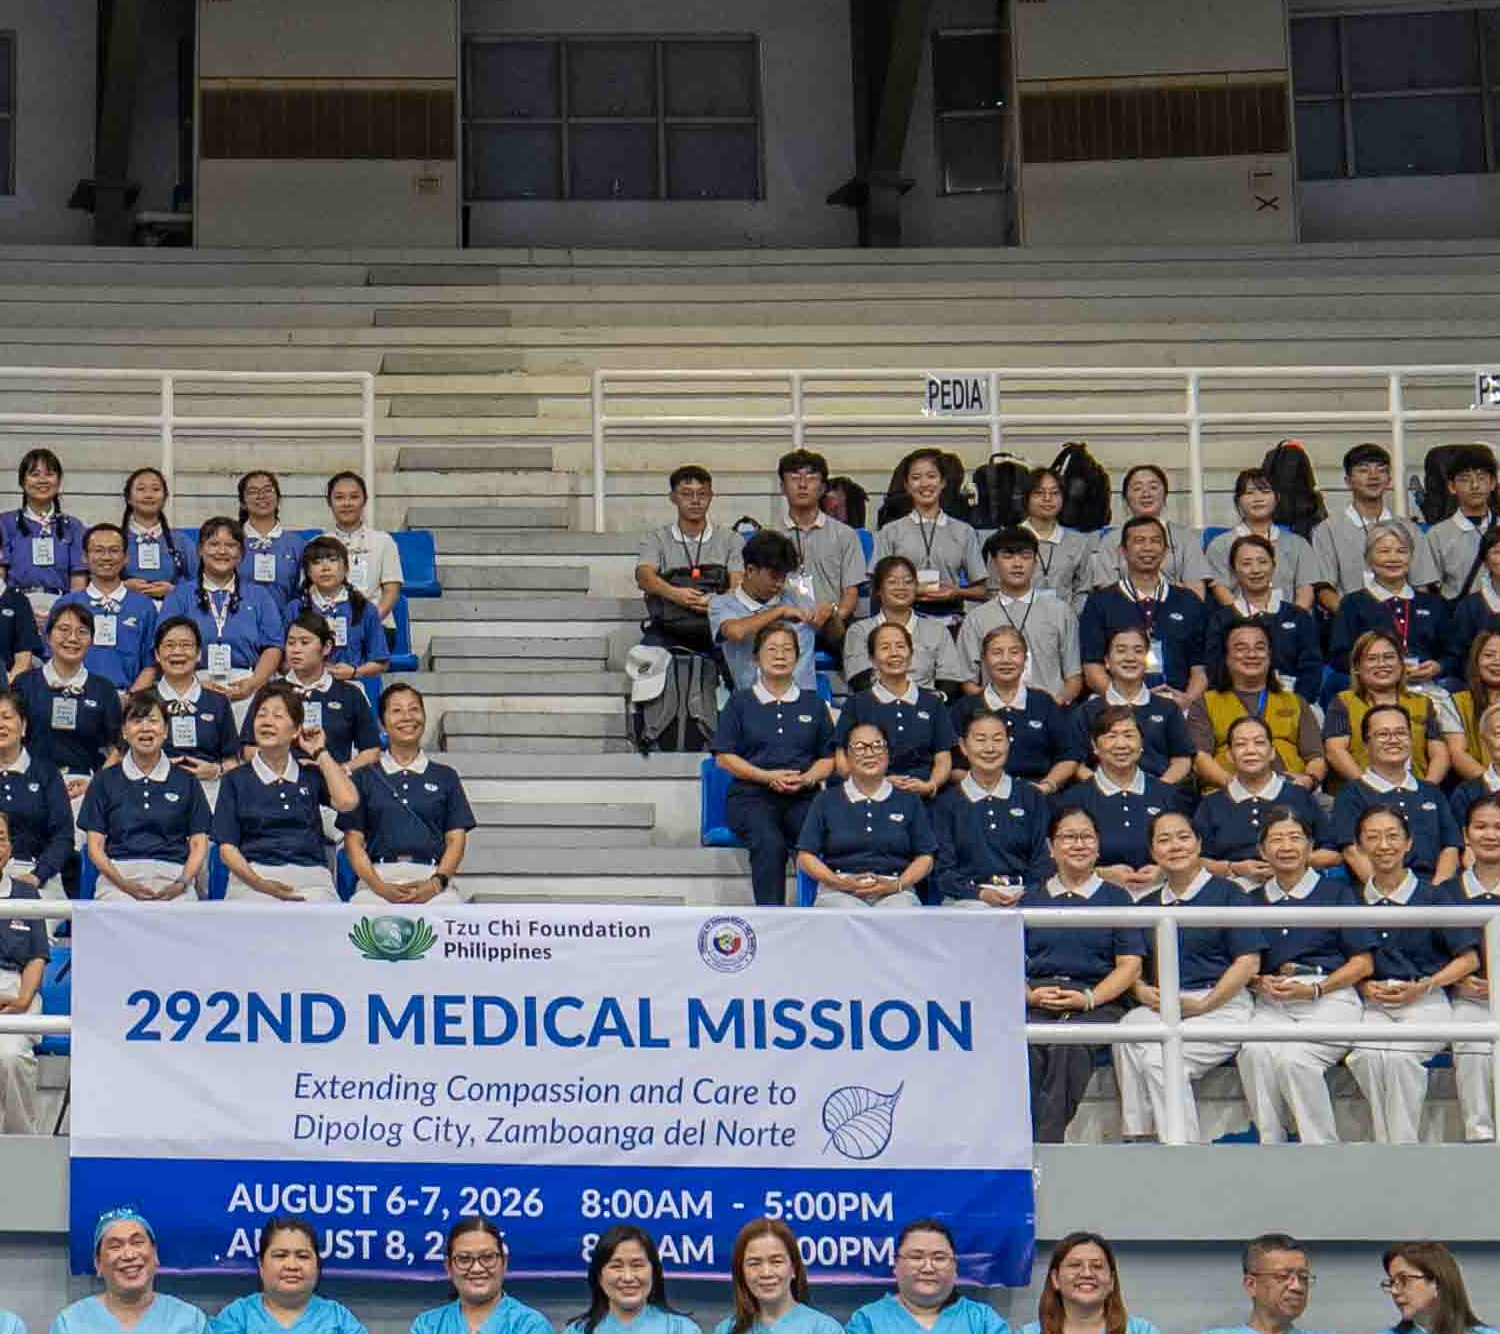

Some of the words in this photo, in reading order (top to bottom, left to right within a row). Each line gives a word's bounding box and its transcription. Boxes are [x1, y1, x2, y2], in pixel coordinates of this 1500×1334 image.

[928, 378, 984, 410] PEDIA
[444, 919, 480, 937] Tzu
[487, 919, 521, 937] Chi
[528, 919, 651, 939] Foundation
[444, 941, 552, 963] Philippines
[125, 989, 347, 1044] 292ND
[367, 994, 670, 1049] MEDICAL
[687, 997, 974, 1052] MISSION
[294, 1072, 439, 1107] Extending
[447, 1074, 620, 1107] Compassion
[629, 1077, 684, 1104] and
[693, 1077, 759, 1105] Care
[767, 1080, 797, 1105] to
[293, 1113, 403, 1148] Dipolog
[412, 1115, 476, 1148] City,
[485, 1117, 654, 1151] Zamboanga
[664, 1118, 706, 1146] del
[715, 1120, 796, 1147] Norte
[227, 1182, 377, 1214] AUGUST
[385, 1185, 450, 1220] 6-7,
[458, 1186, 545, 1217] 2026
[580, 1188, 713, 1220] 8:00AM
[764, 1191, 894, 1222] 5:00PM
[385, 1229, 415, 1266] 8,
